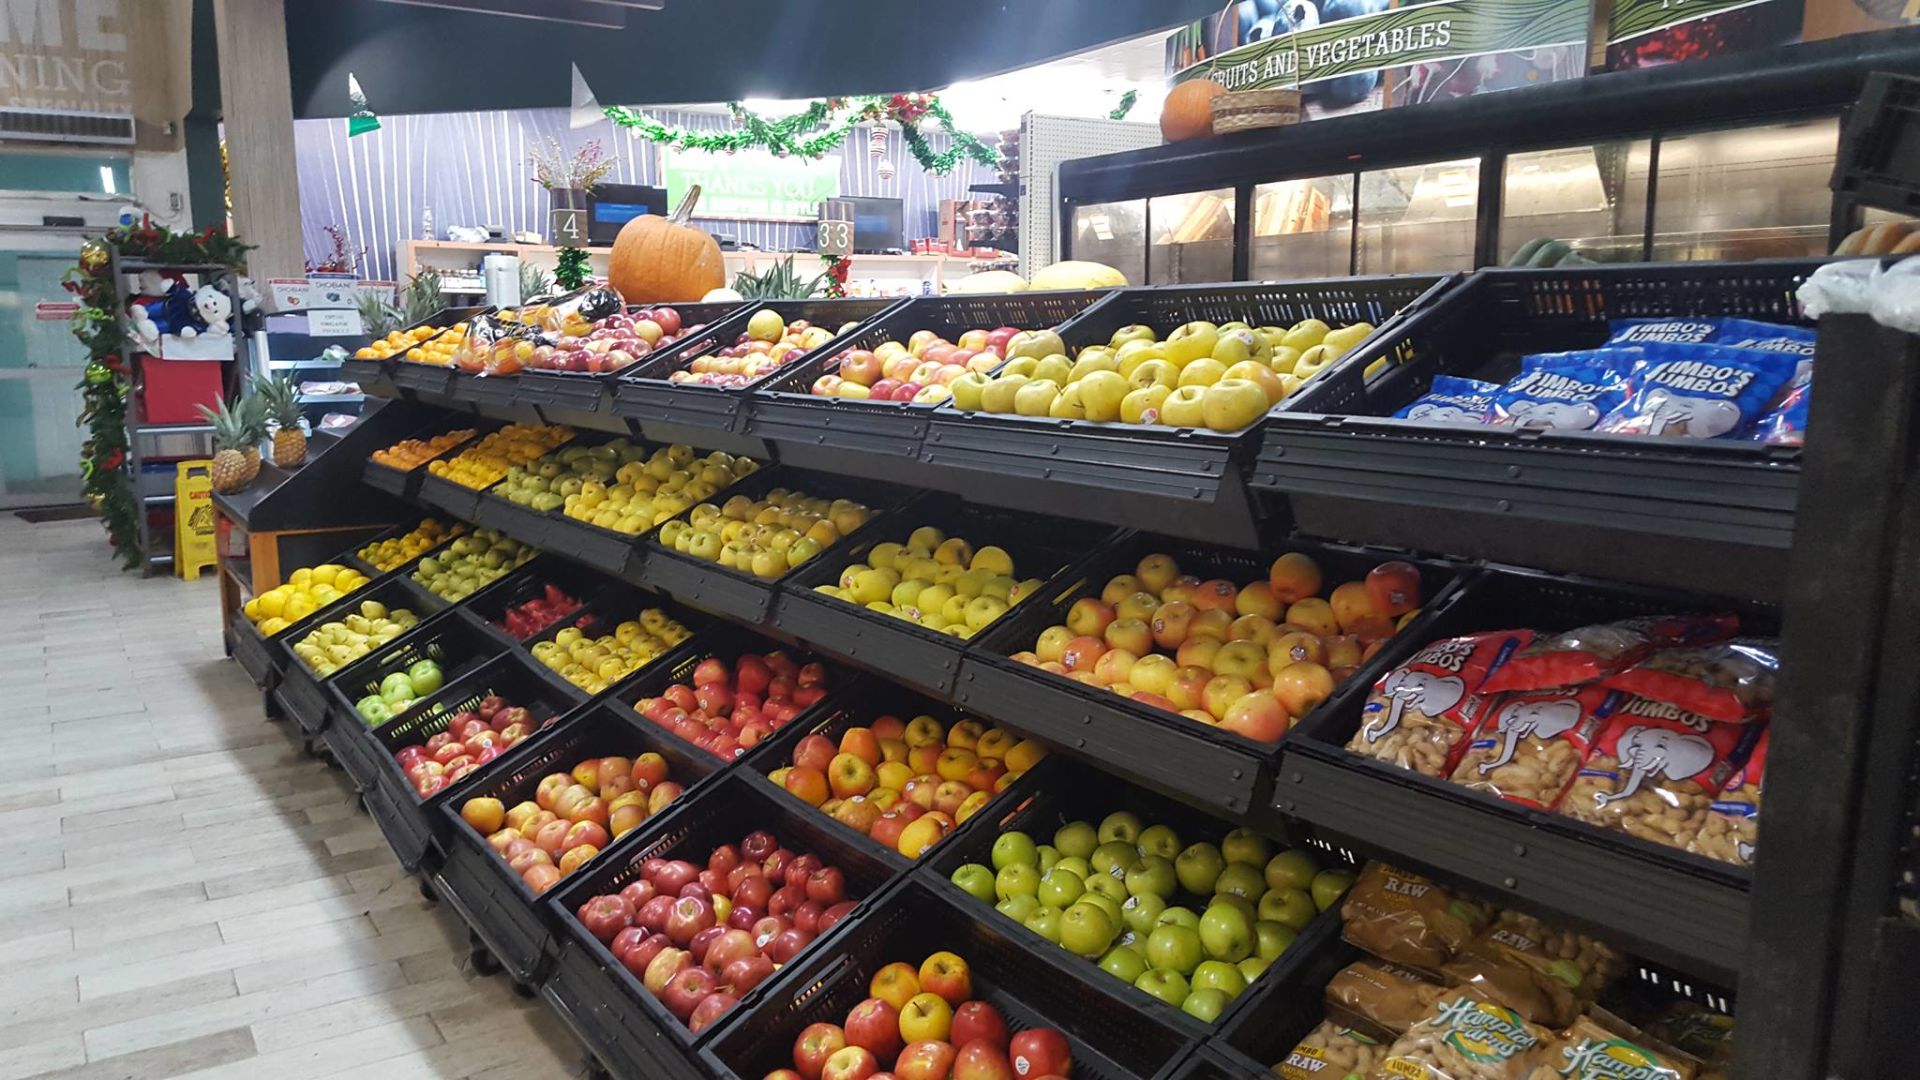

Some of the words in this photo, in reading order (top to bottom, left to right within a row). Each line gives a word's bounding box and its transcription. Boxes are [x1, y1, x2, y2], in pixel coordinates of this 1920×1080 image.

[1263, 49, 1298, 78] AND
[1306, 20, 1450, 69] VEGETABLES
[682, 173, 767, 197] THANKS
[772, 176, 814, 199] YOU
[562, 212, 579, 239] 4
[1384, 876, 1430, 898] RAW
[1491, 930, 1536, 951] RAW
[1430, 997, 1538, 1047] Hampton
[1441, 1027, 1523, 1058] Farms
[1285, 1053, 1329, 1072] RAW
